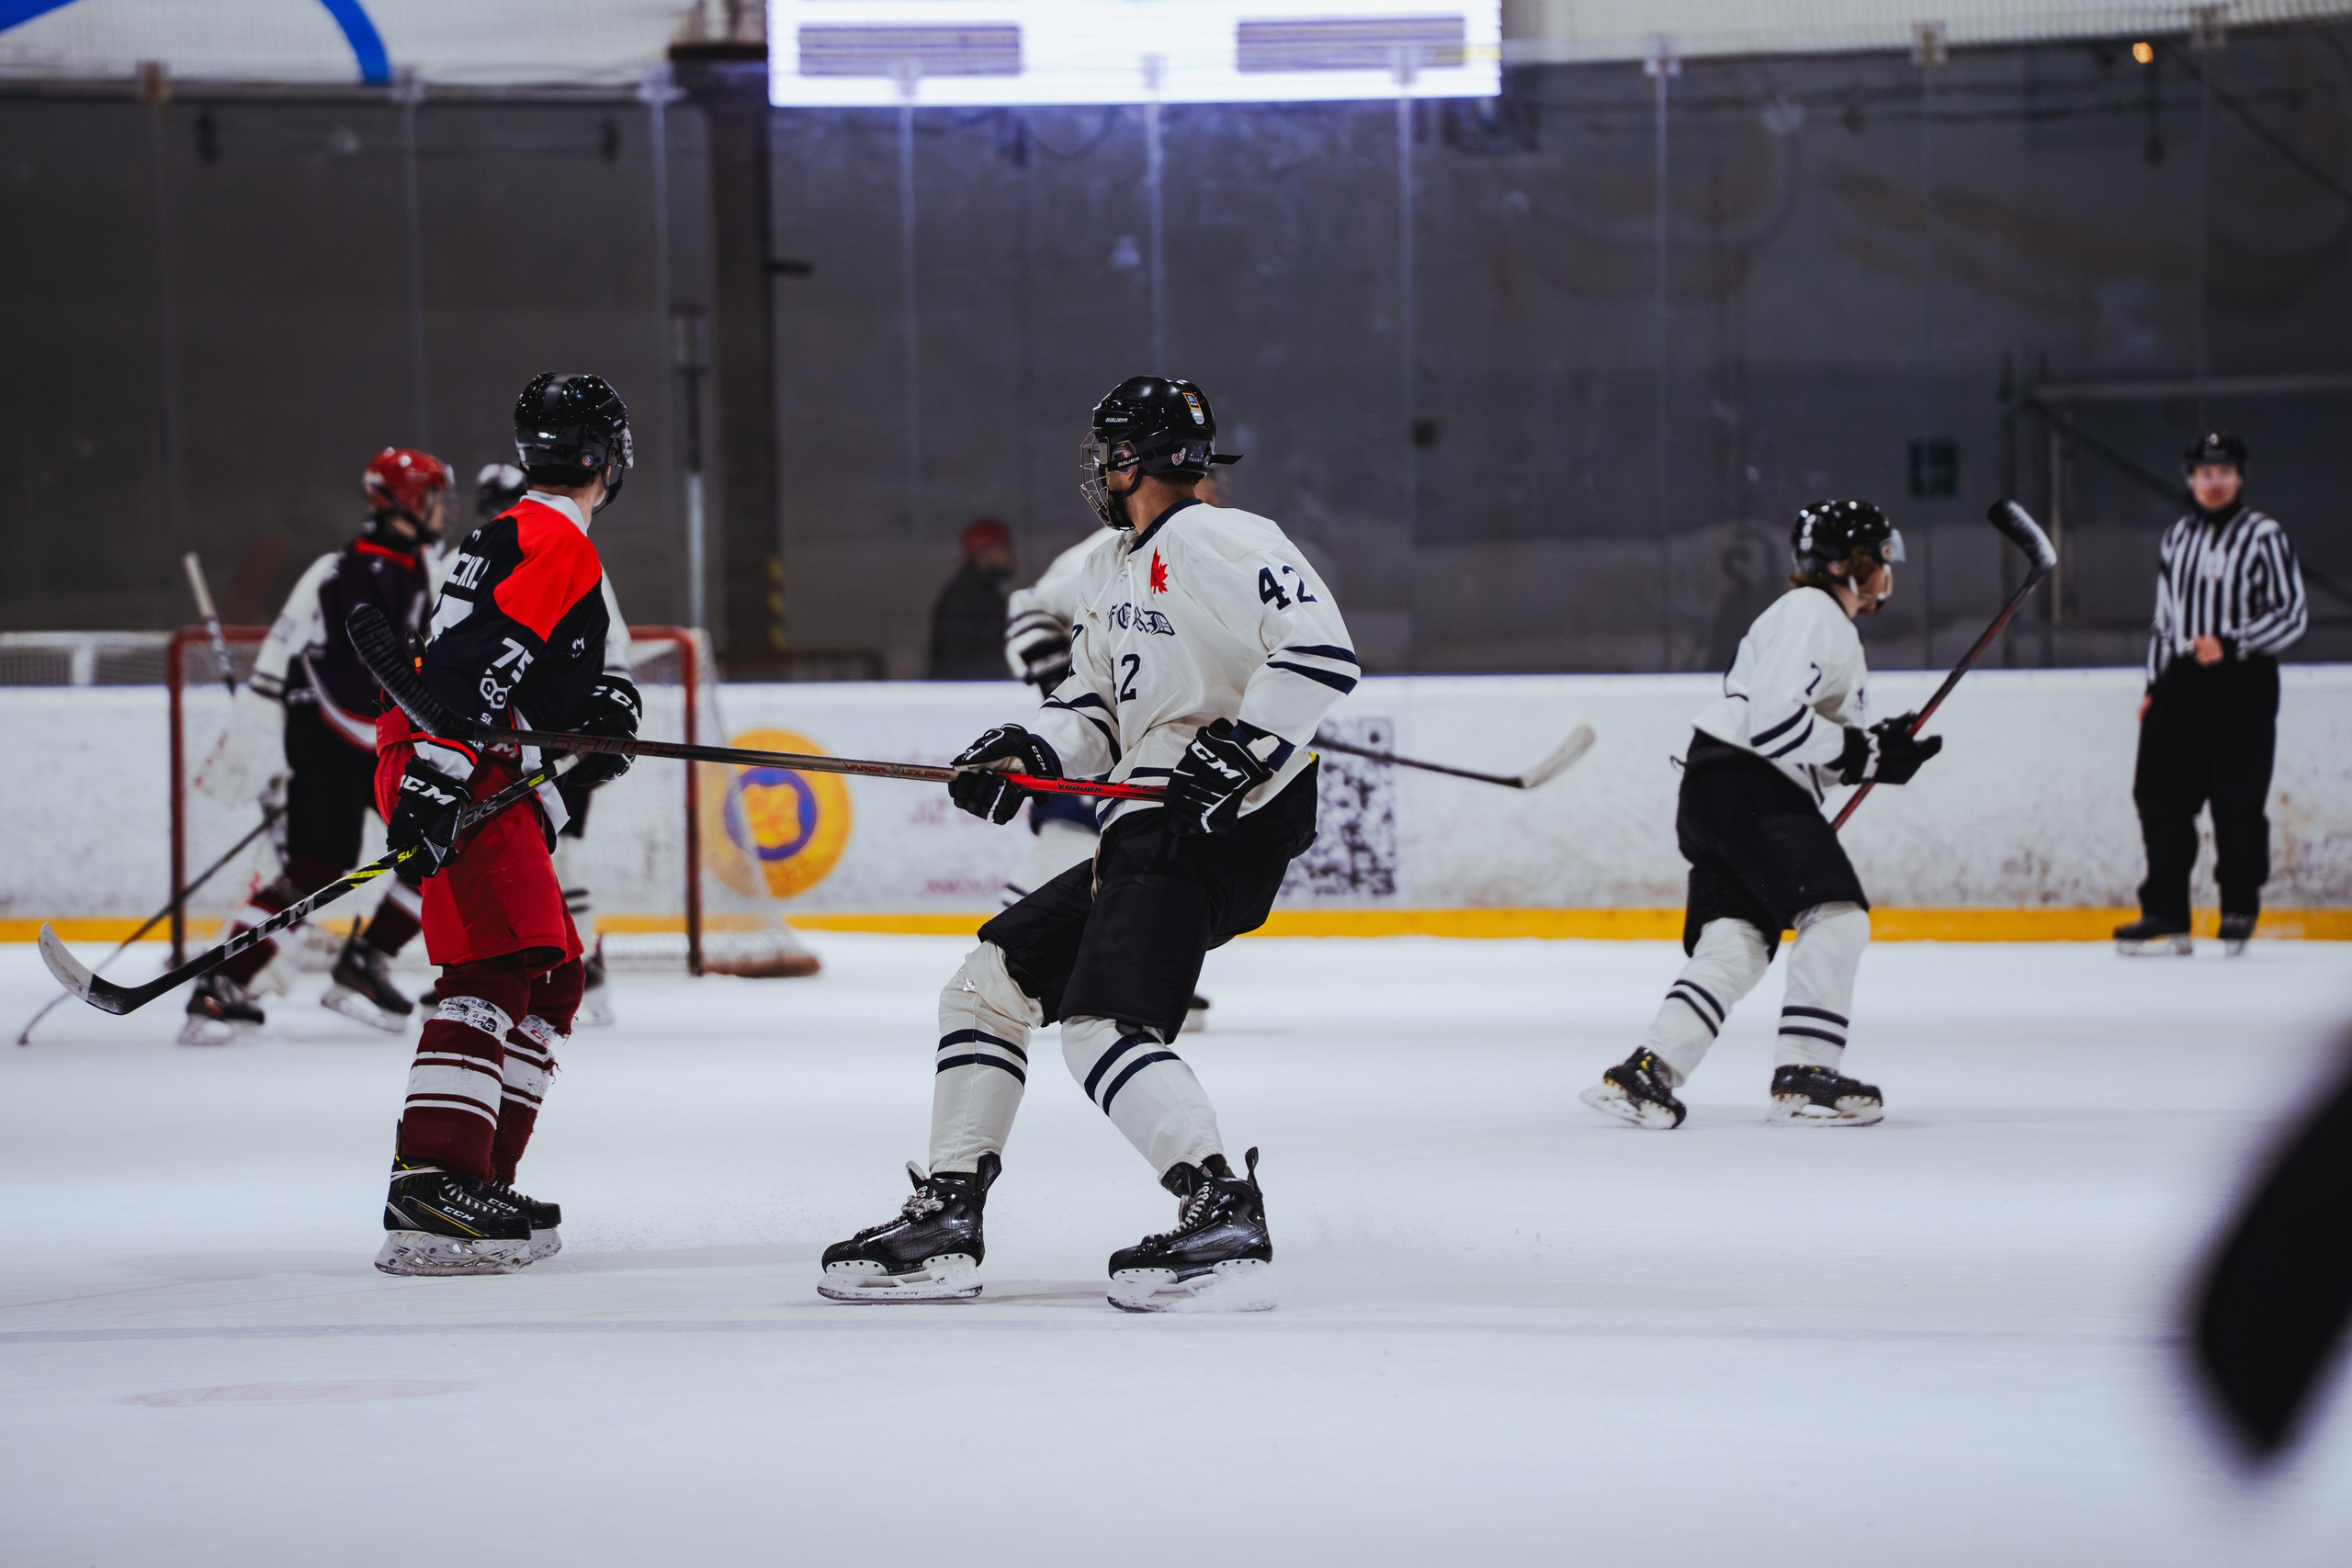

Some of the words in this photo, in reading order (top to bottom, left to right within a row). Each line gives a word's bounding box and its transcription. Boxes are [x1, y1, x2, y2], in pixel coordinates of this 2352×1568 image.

[1117, 457, 1140, 468] BAUER
[1258, 565, 1318, 611] 42
[1107, 602, 1176, 636] FORD
[842, 761, 889, 775] VAPOR
[1031, 745, 1047, 771] CCM
[1191, 739, 1243, 780] CM
[1065, 784, 1103, 793] BAUER
[223, 896, 315, 961] CCM
[443, 1205, 475, 1221] CCM
[487, 1197, 519, 1213] CCM
